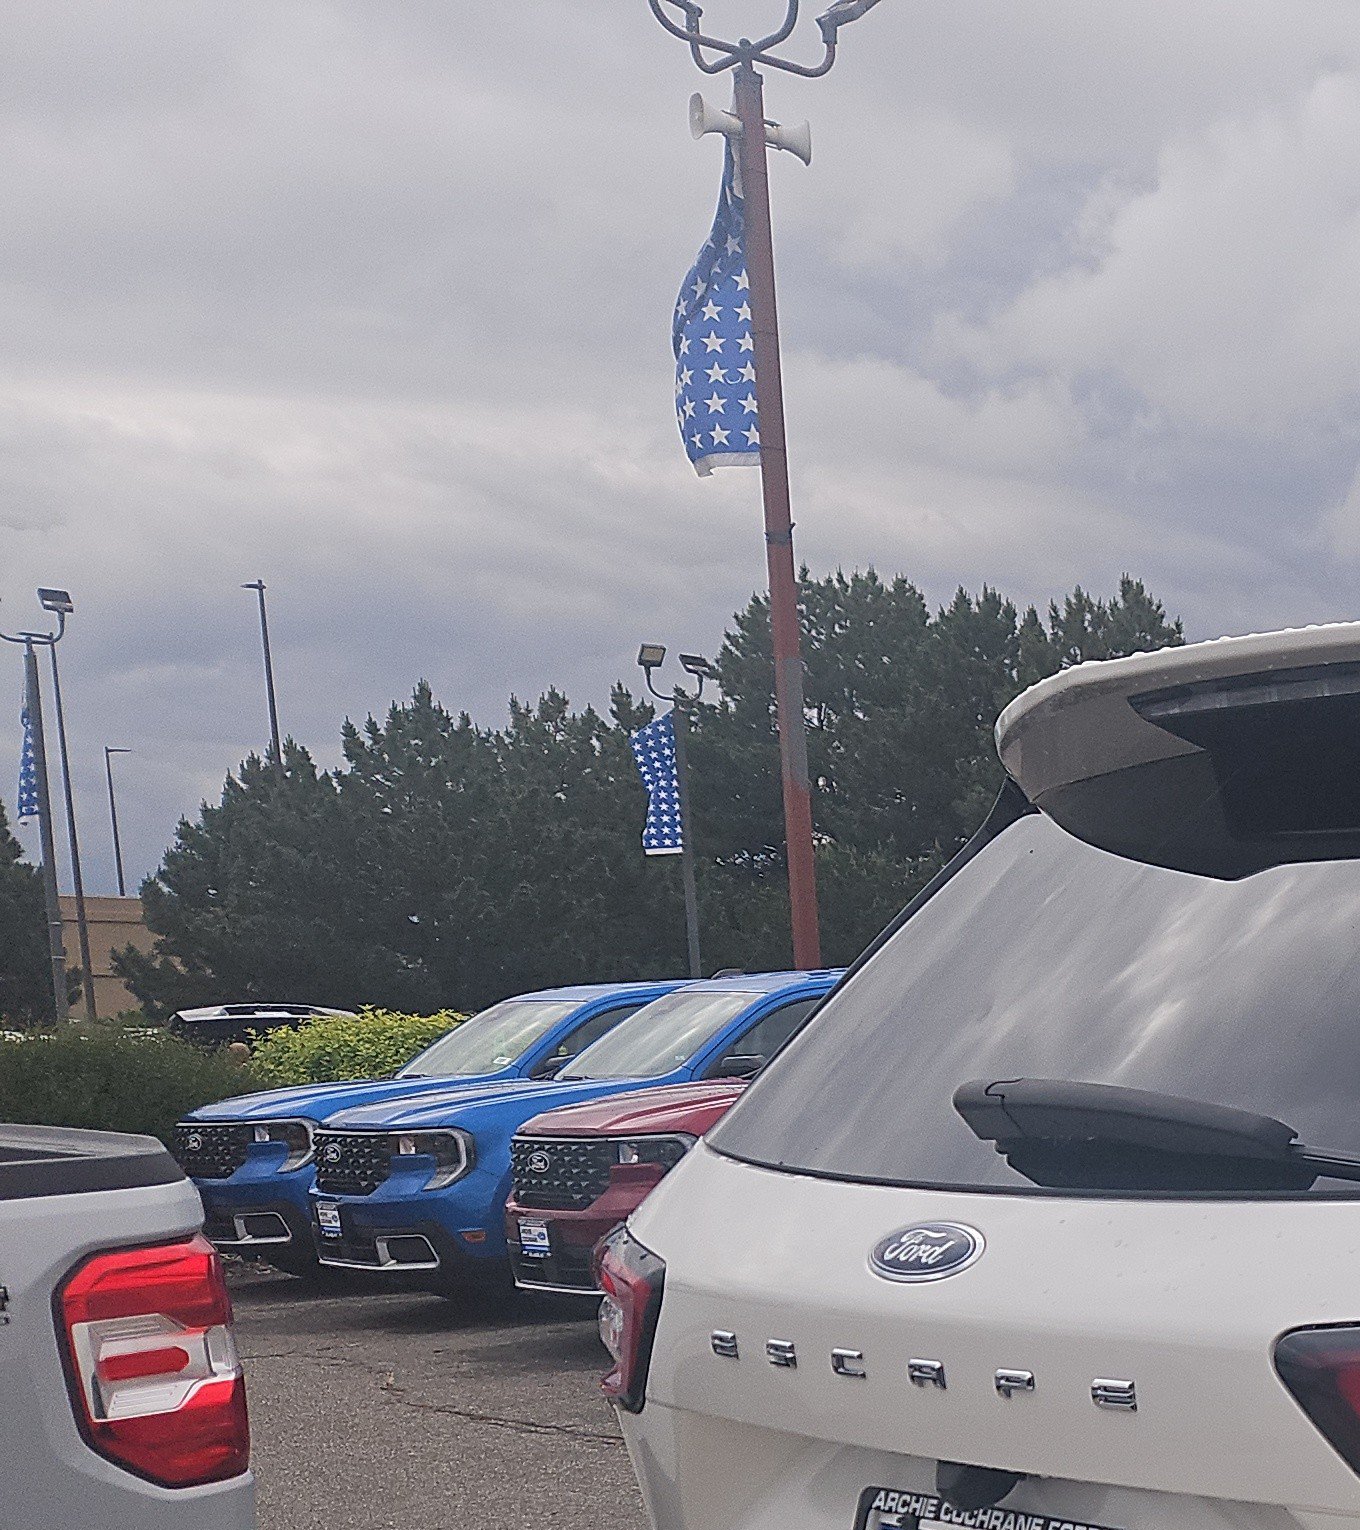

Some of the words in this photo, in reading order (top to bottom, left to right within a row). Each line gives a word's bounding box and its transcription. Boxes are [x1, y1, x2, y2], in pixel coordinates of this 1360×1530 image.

[883, 1229, 955, 1264] Ford
[711, 1330, 1138, 1412] ESCAPE
[872, 1490, 938, 1518] ARCHIE
